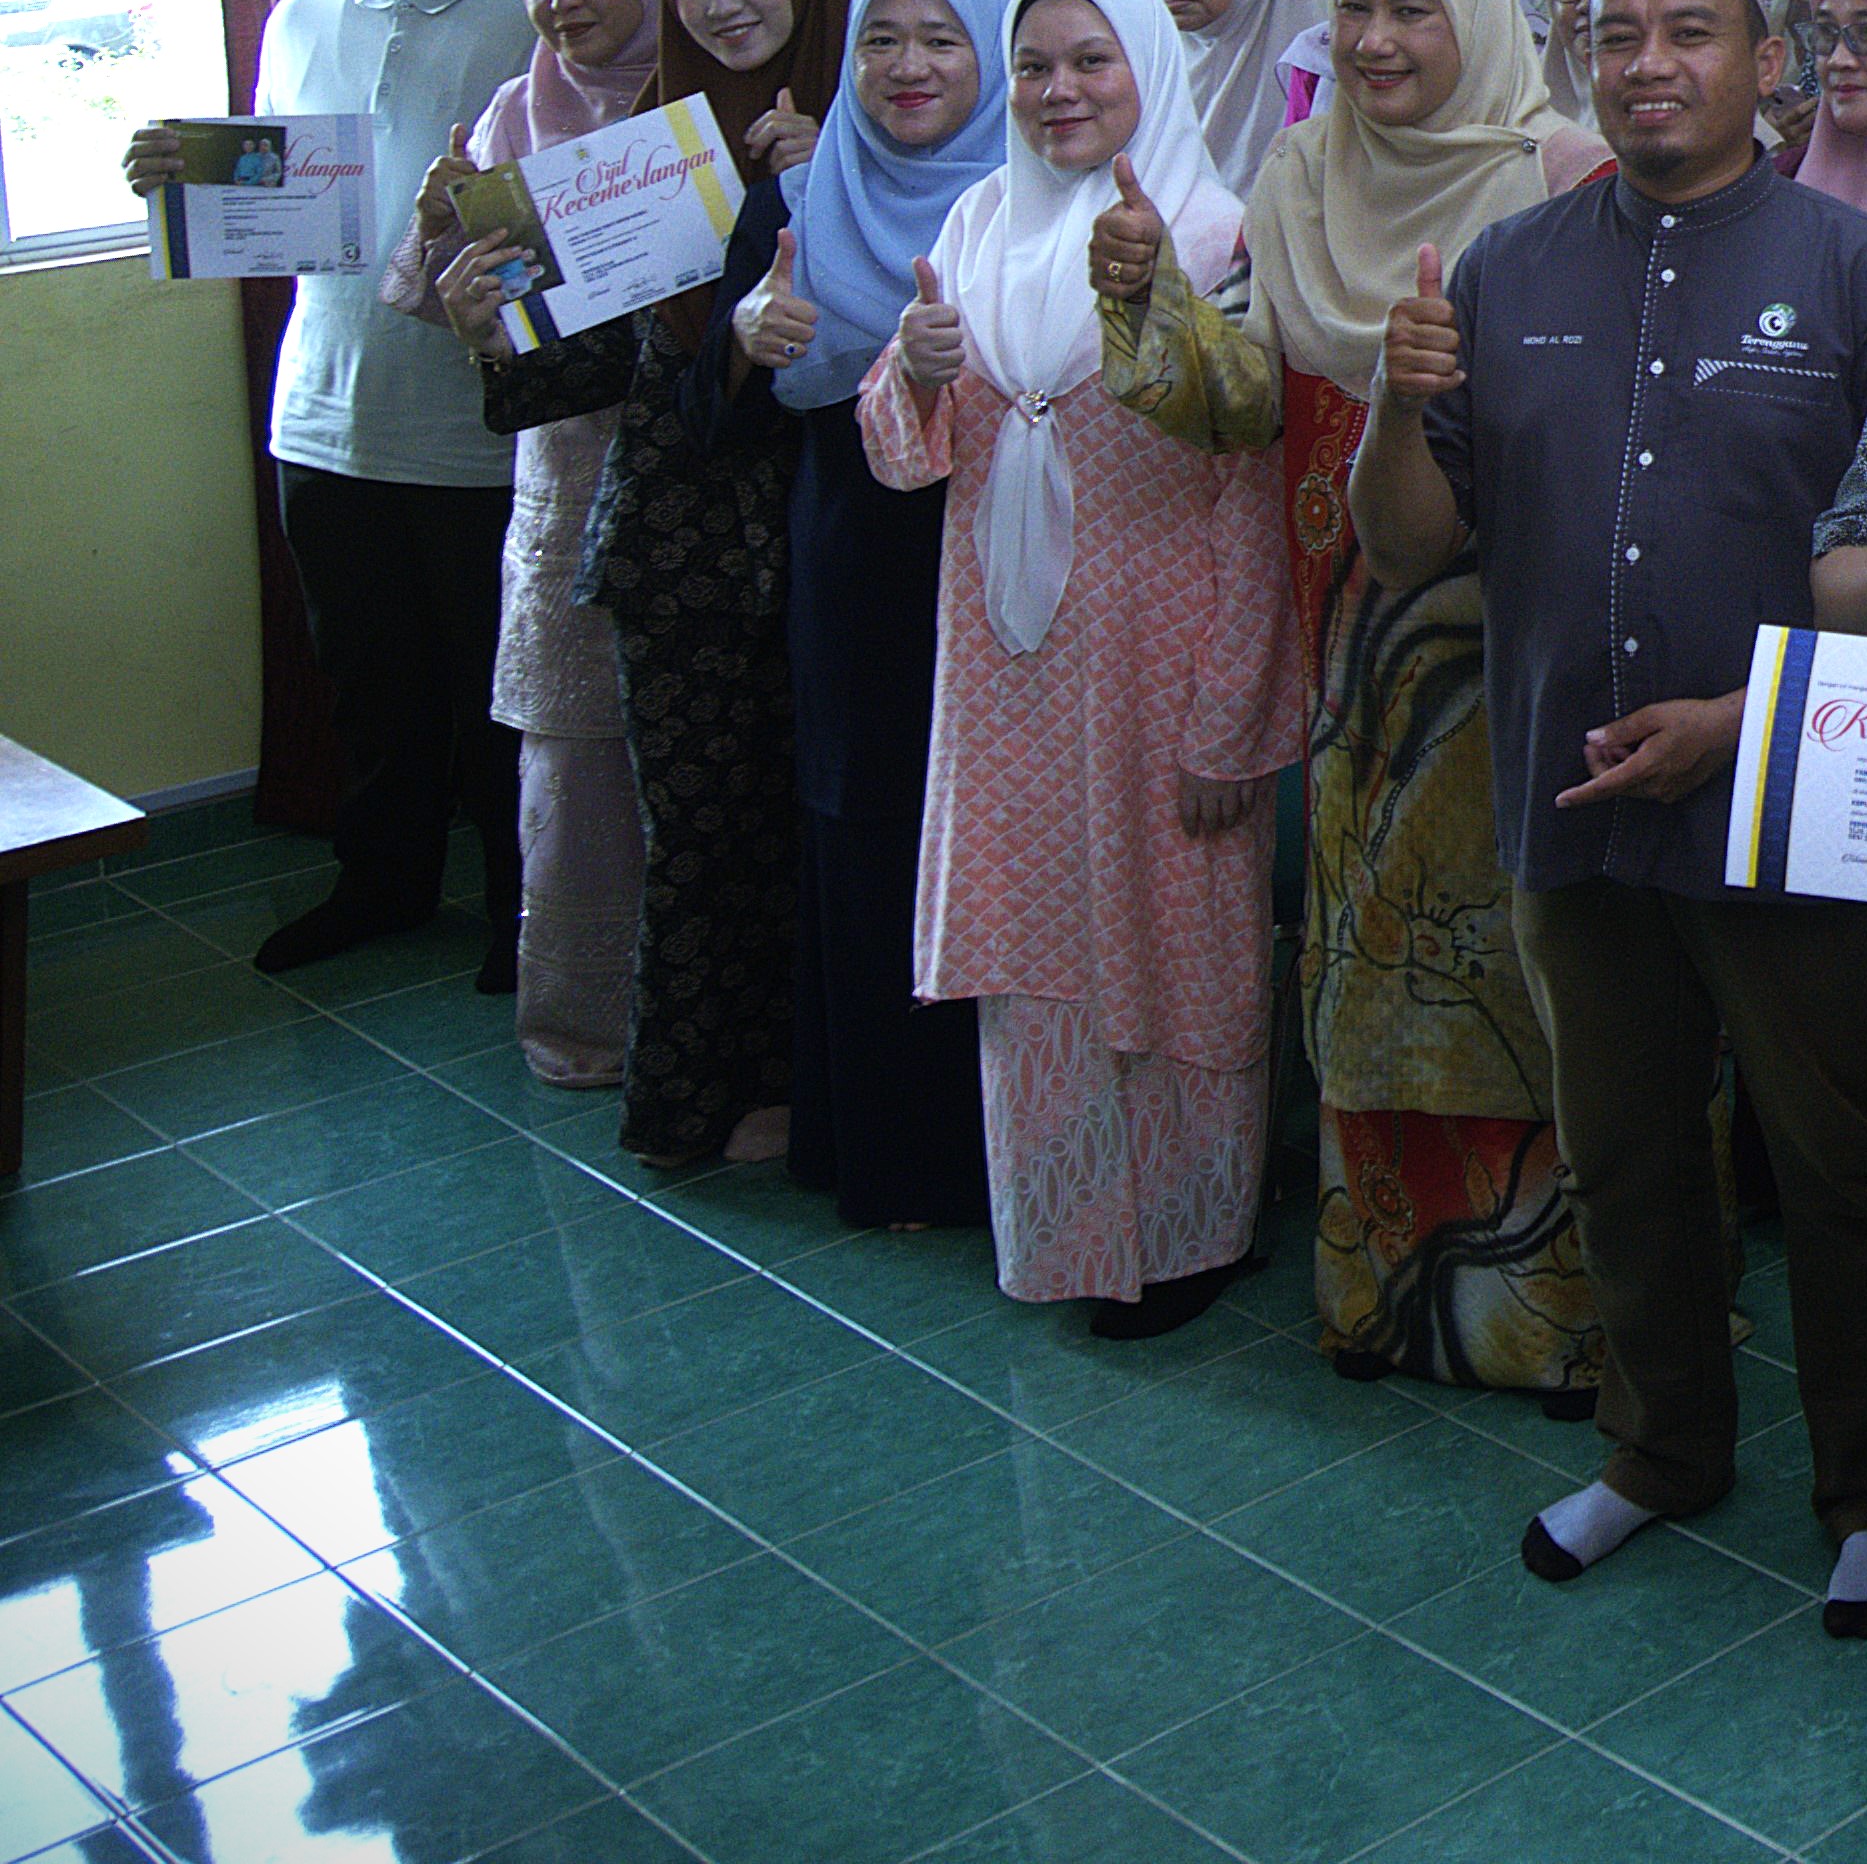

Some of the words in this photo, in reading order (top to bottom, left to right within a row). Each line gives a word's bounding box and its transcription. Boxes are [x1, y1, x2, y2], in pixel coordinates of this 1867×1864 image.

[575, 139, 647, 194] Sijil
[536, 145, 716, 225] Kecemerlangan
[1549, 336, 1560, 344] AL
[1740, 335, 1810, 350] Terengganu
